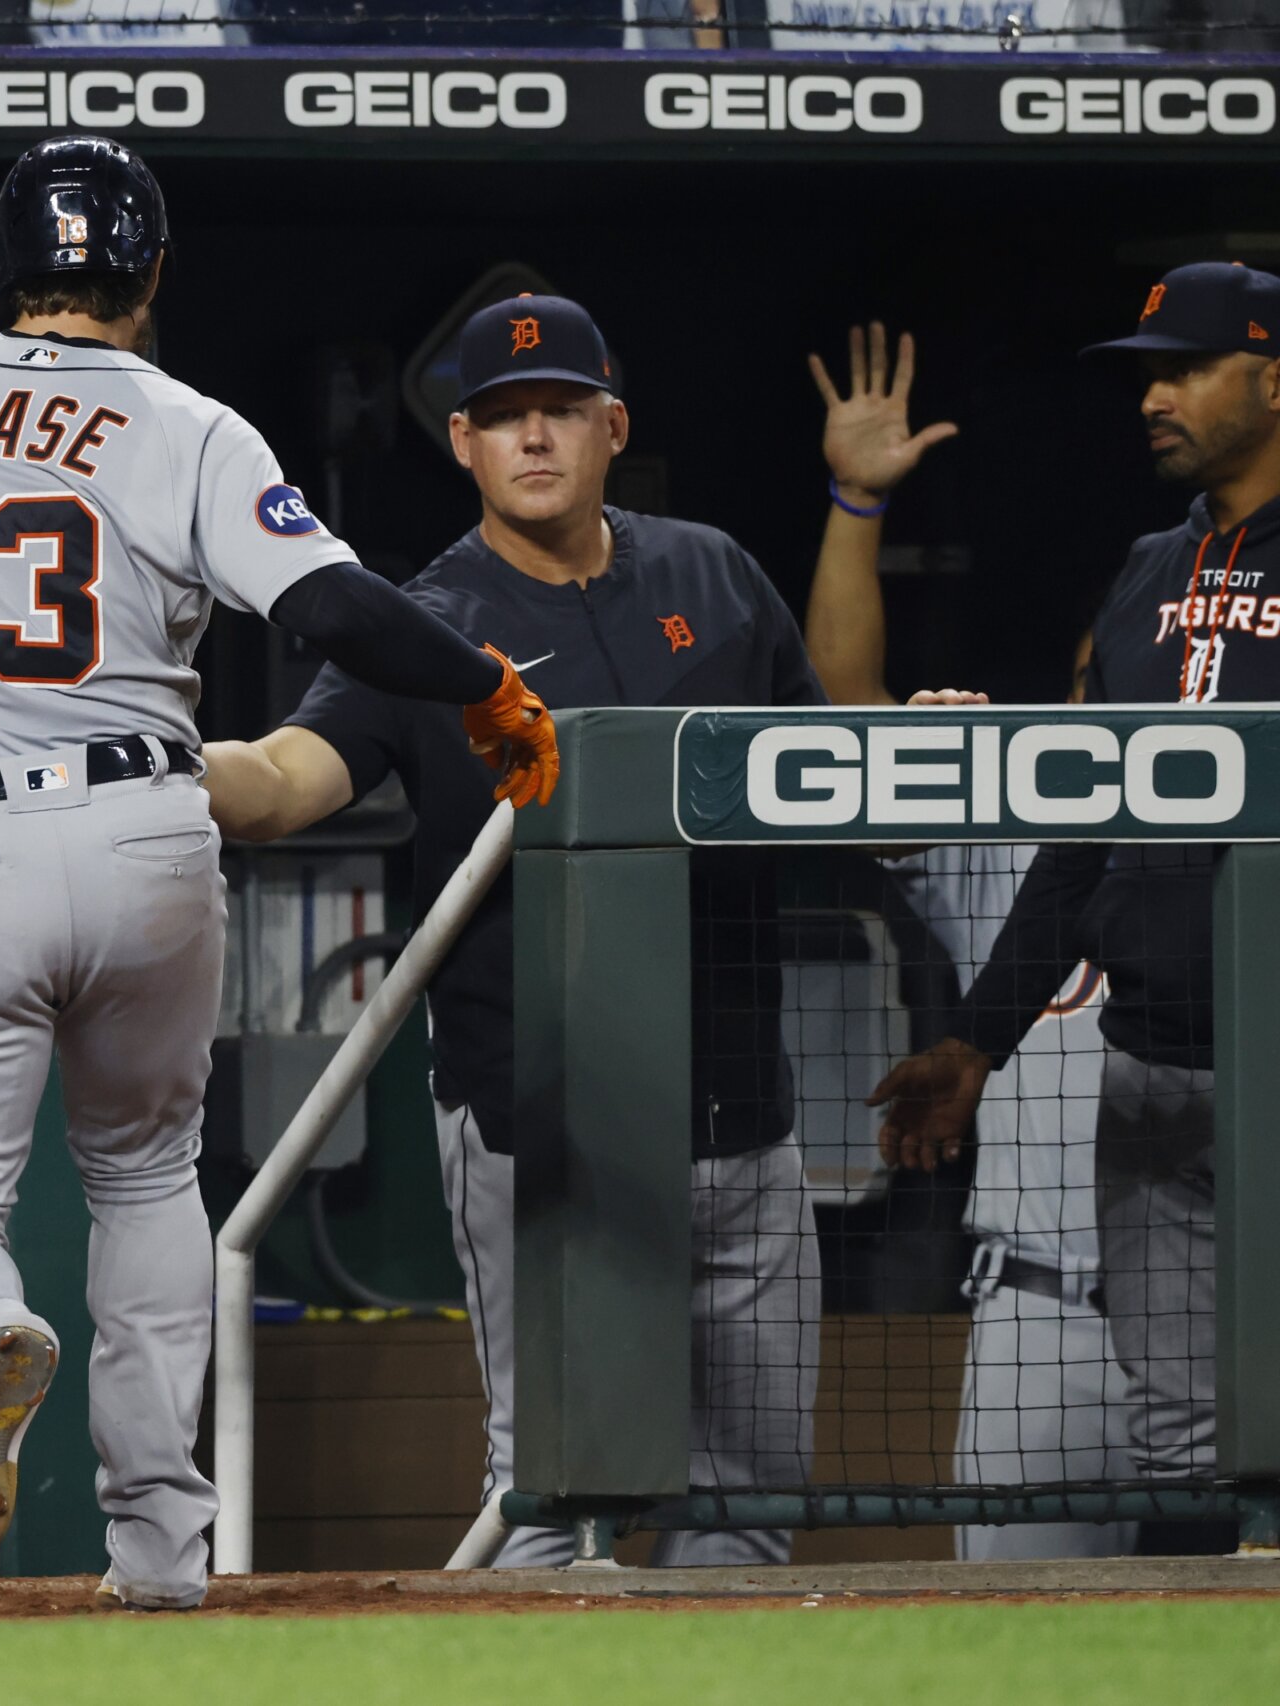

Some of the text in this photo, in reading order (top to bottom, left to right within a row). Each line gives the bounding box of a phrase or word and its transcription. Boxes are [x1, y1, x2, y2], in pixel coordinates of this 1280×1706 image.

[284, 71, 567, 129] GEICO
[644, 73, 923, 133] GEICO
[1000, 78, 1277, 134] GEICO
[56, 214, 88, 245] 13
[508, 316, 542, 357] D
[266, 498, 311, 527] KB
[656, 613, 696, 655] D
[745, 723, 1247, 826] GEICO
